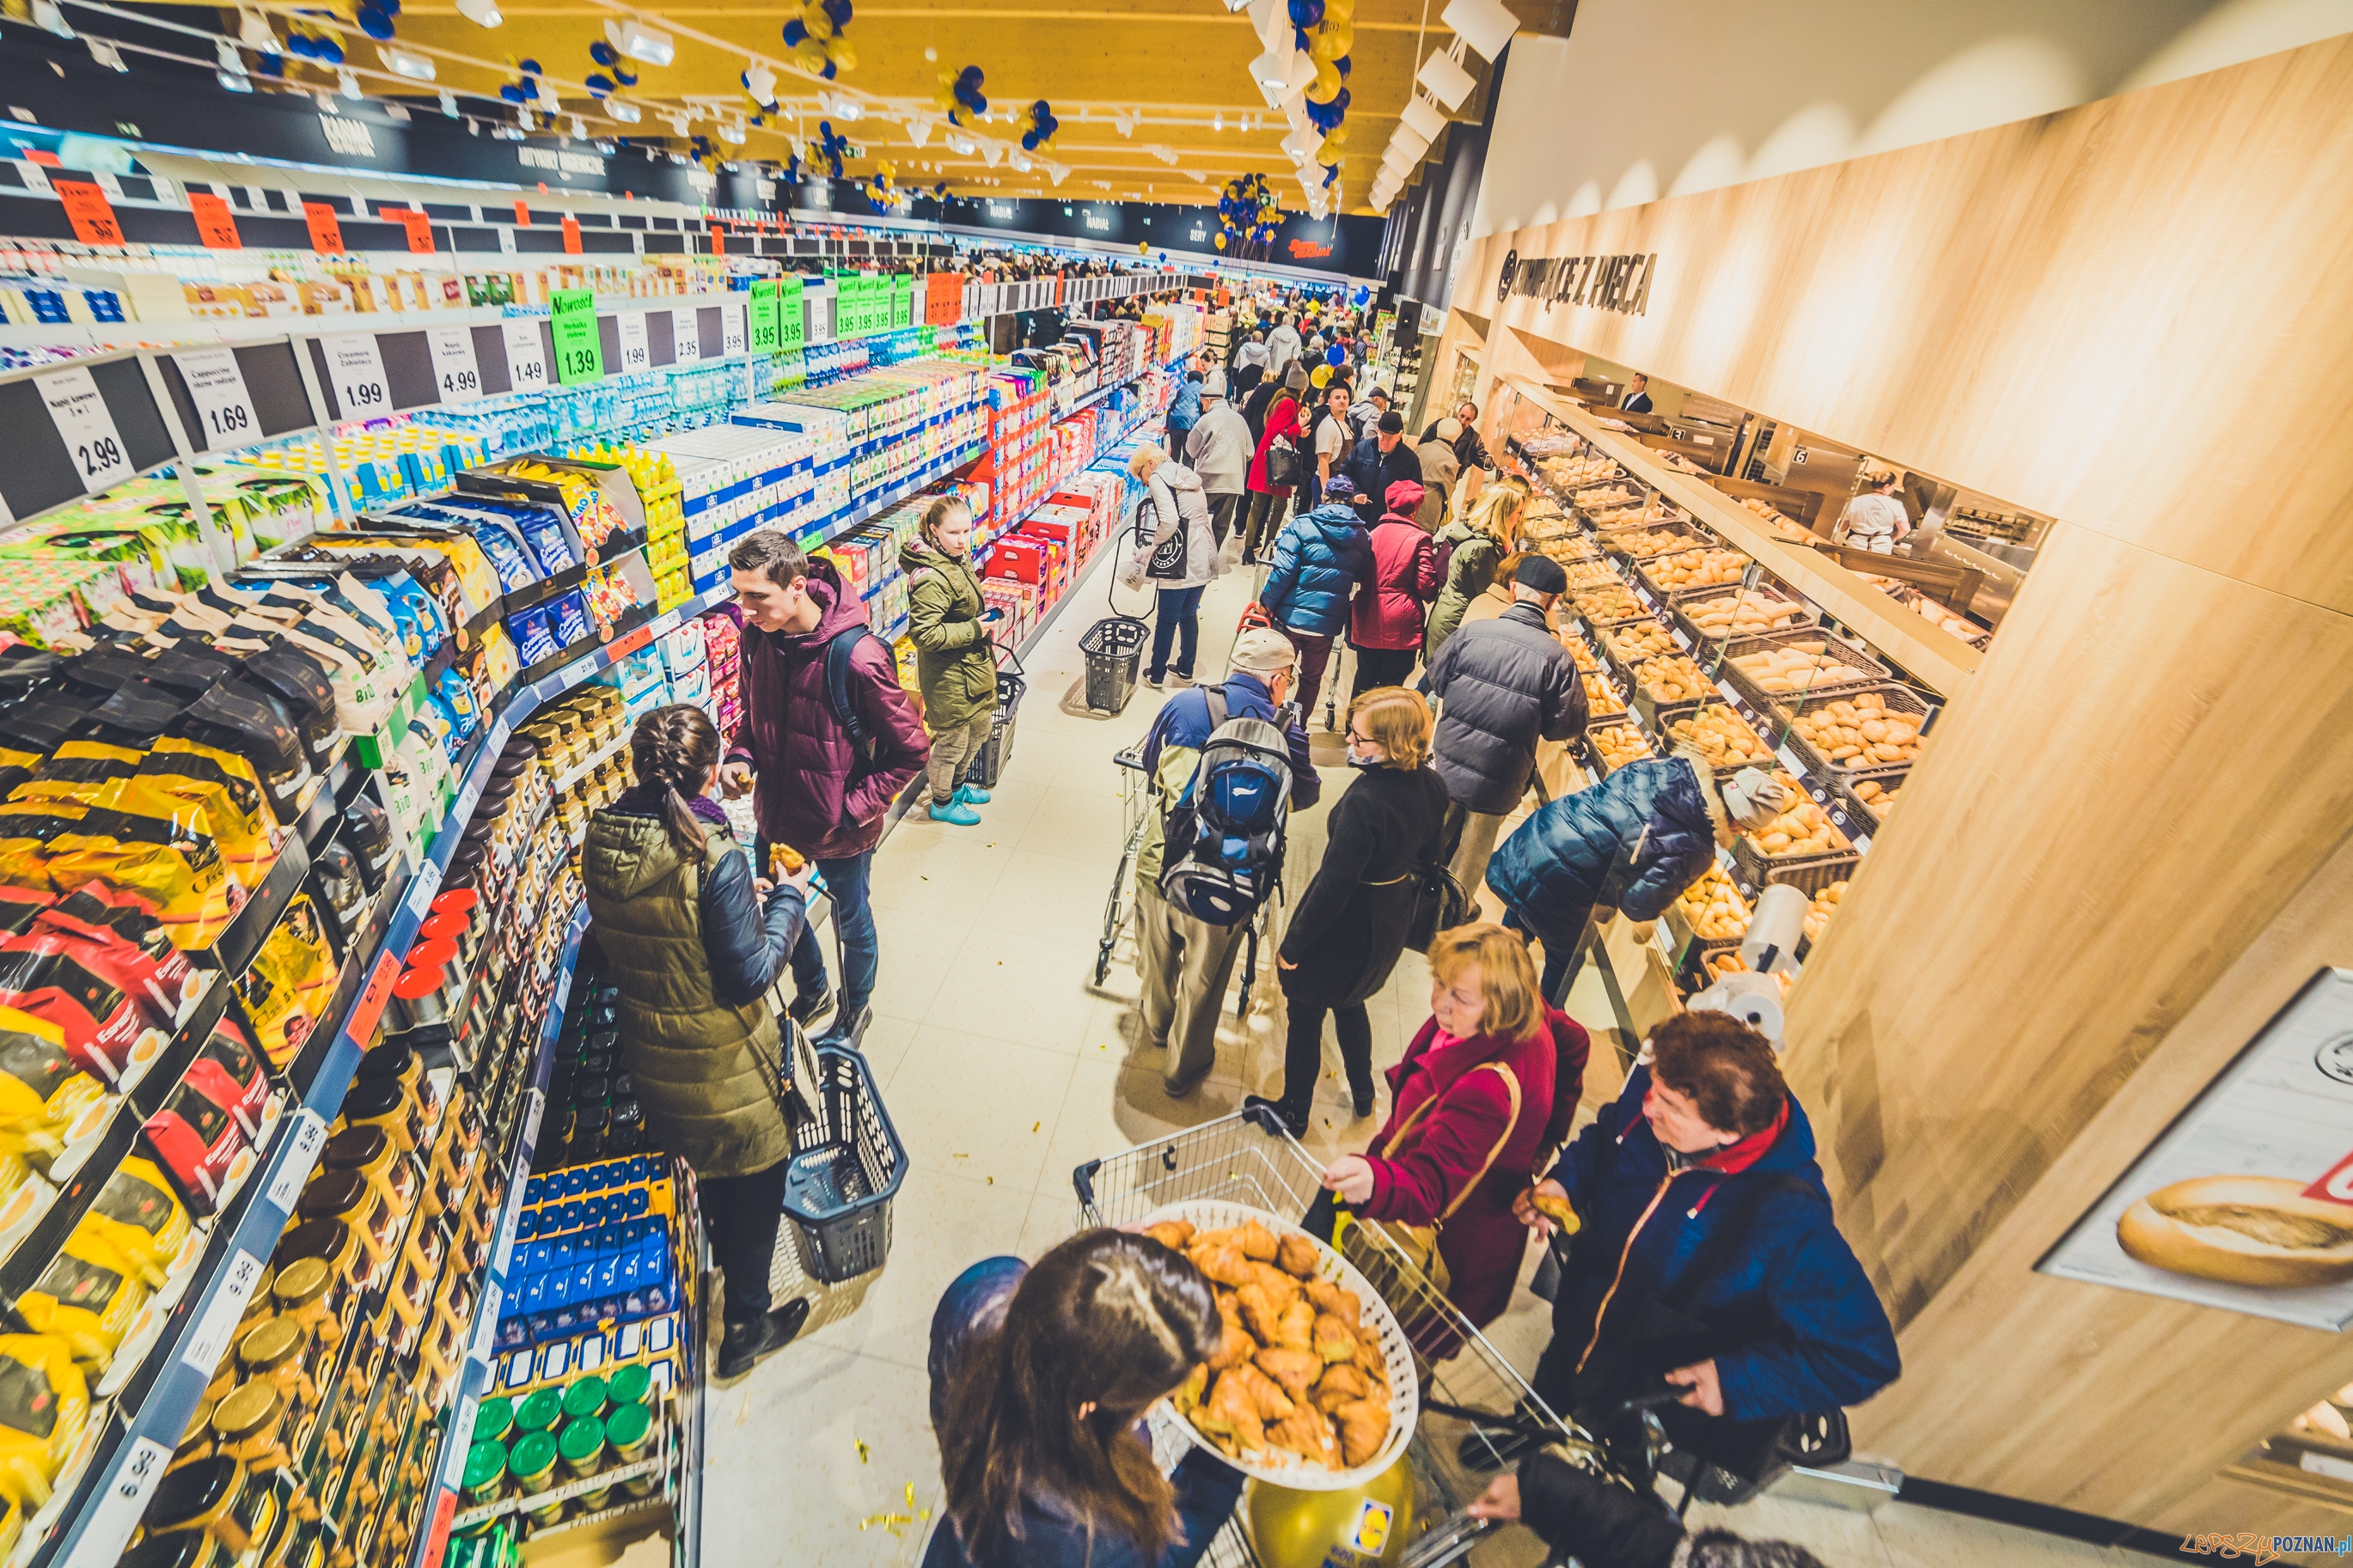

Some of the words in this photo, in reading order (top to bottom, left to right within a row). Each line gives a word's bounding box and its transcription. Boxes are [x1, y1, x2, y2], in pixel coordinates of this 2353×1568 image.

[1189, 229, 1207, 242] SERY
[1572, 256, 1596, 306] Z
[1587, 253, 1658, 317] PIECA
[553, 293, 592, 314] Nowość!
[840, 316, 853, 333] 3.95
[859, 314, 871, 330] 3.95
[877, 312, 888, 327] 3.95
[896, 309, 908, 325] 3.95
[755, 326, 774, 345] 3.95
[785, 323, 801, 342] 3.95
[815, 323, 825, 336] 3.95
[679, 341, 697, 357] 2.35
[726, 334, 742, 349] 3.95
[565, 349, 594, 376] 1.39
[626, 348, 644, 364] 1.99
[516, 362, 541, 382] 1.49
[444, 370, 476, 393] 4.99
[347, 382, 382, 407] 1.99
[211, 405, 248, 434] 1.69
[1675, 430, 1682, 439] 3
[79, 436, 121, 477] 2.99
[1796, 451, 1806, 462] 6
[119, 1447, 156, 1498] 6.99
